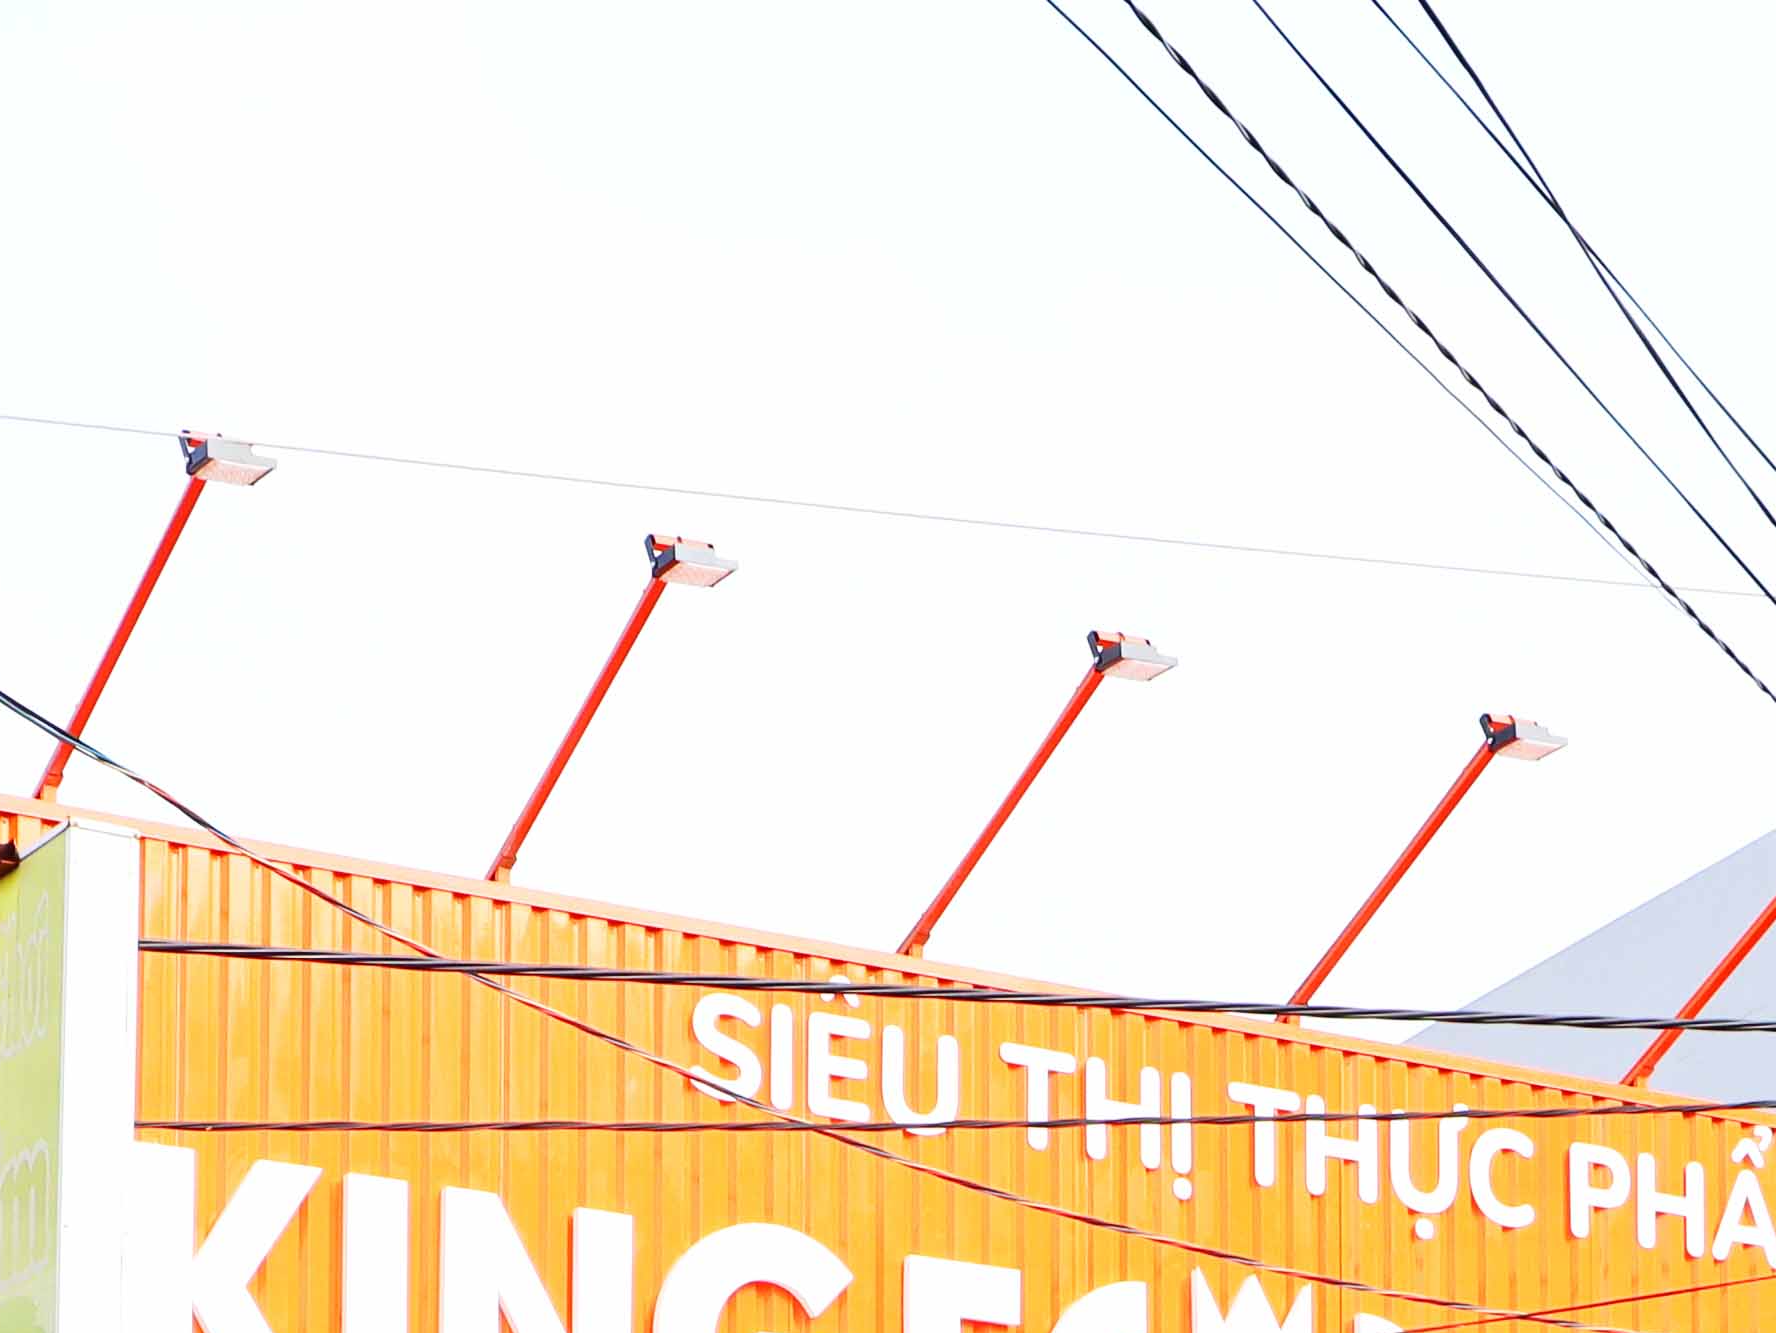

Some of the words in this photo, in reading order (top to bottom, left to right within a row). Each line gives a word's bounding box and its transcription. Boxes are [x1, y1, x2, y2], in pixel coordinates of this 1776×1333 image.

[688, 975, 960, 1137] SIÊU
[1001, 1040, 1194, 1201] THỊ
[1227, 1082, 1536, 1243] THỰC
